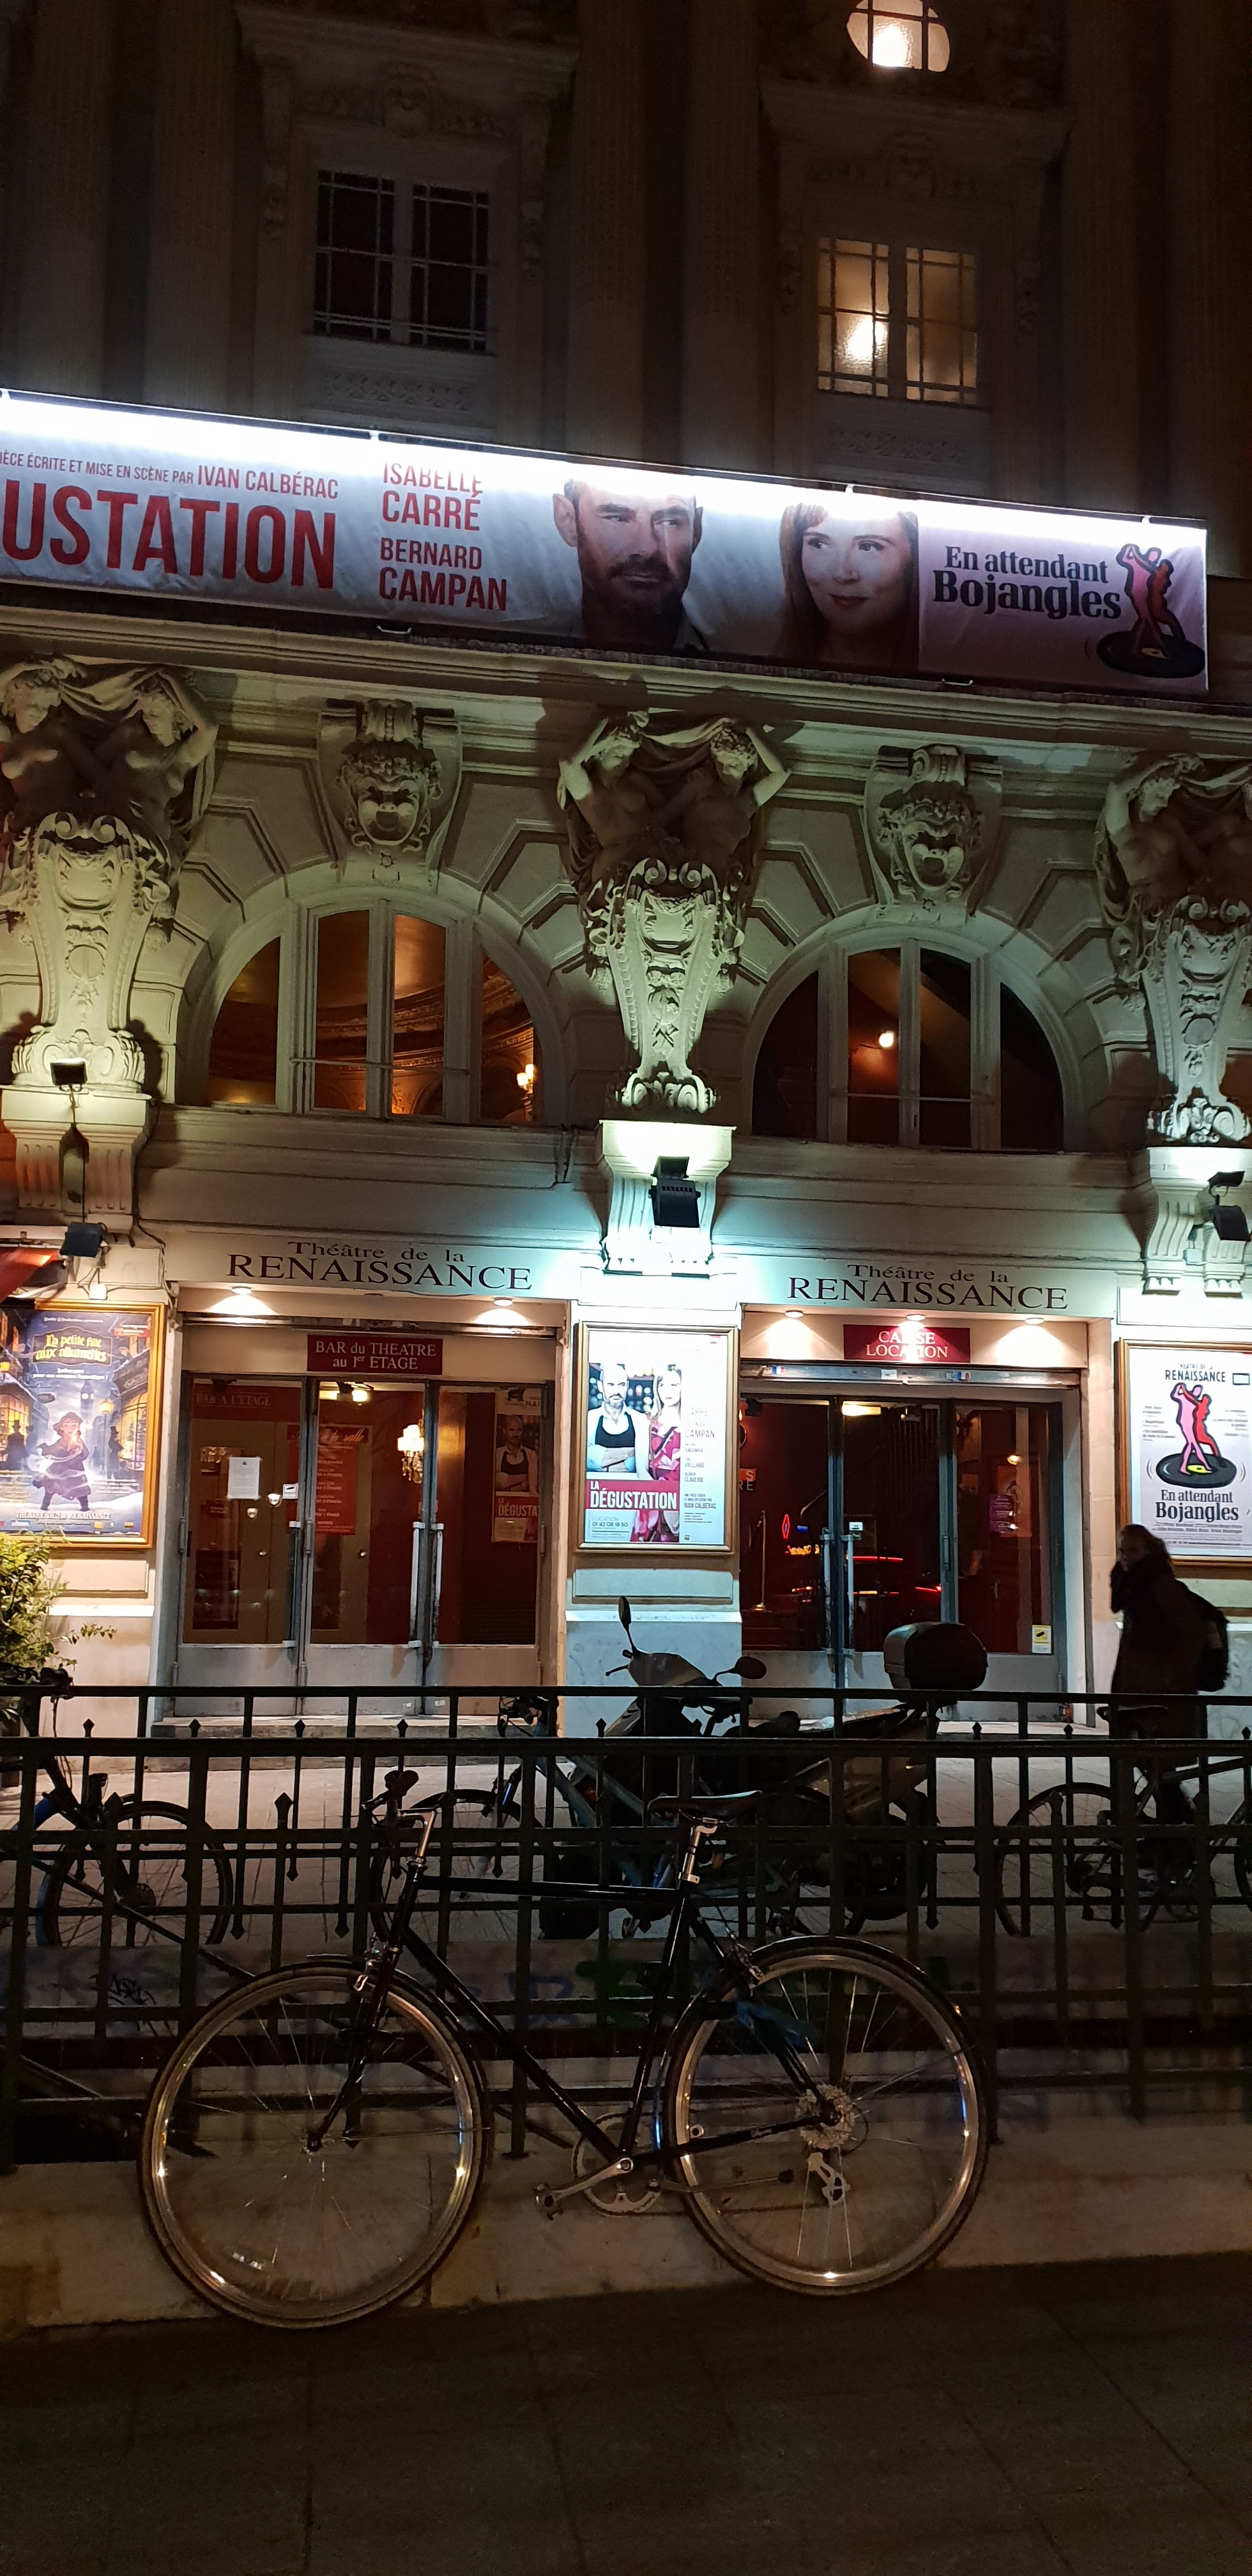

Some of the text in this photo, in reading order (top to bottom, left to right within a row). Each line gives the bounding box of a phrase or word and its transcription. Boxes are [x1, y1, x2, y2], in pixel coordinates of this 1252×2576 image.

[27, 452, 66, 471] ÉCRITE
[70, 459, 82, 473] ET
[86, 461, 113, 477] MISE
[116, 464, 130, 479] EN
[134, 466, 169, 482] SCÈNE
[172, 470, 194, 484] PAR
[197, 464, 240, 489] IVAN
[245, 471, 339, 499] CALBÉRAC
[383, 462, 483, 493] ISABELLE
[382, 490, 481, 532] CARRÉ
[2, 479, 335, 590] USTATION
[380, 537, 482, 570] BERNARD
[945, 546, 1110, 584] En attendant
[379, 567, 507, 611] CAMPAN
[933, 569, 1122, 620] Bojangles
[287, 1241, 464, 1262] Théâtre de la
[227, 1254, 533, 1290] RENAISSANCE
[848, 1264, 1009, 1284] Théâtre de la
[788, 1276, 1068, 1310] RENAISSANCE
[878, 1330, 936, 1346] CASE
[315, 1341, 437, 1357] BAR du THEATRE
[866, 1343, 948, 1360] LOCAION
[332, 1358, 347, 1368] au
[369, 1356, 418, 1370] ETAGE
[1165, 1369, 1226, 1382] RENAISSANCE
[685, 1429, 715, 1439] CAMPAN
[590, 1481, 599, 1489] LA
[590, 1487, 677, 1510] DÉGUSTATION
[1161, 1490, 1233, 1503] En attendant
[498, 1503, 540, 1517] DÉGUSTA
[1156, 1502, 1239, 1522] Bojangles
